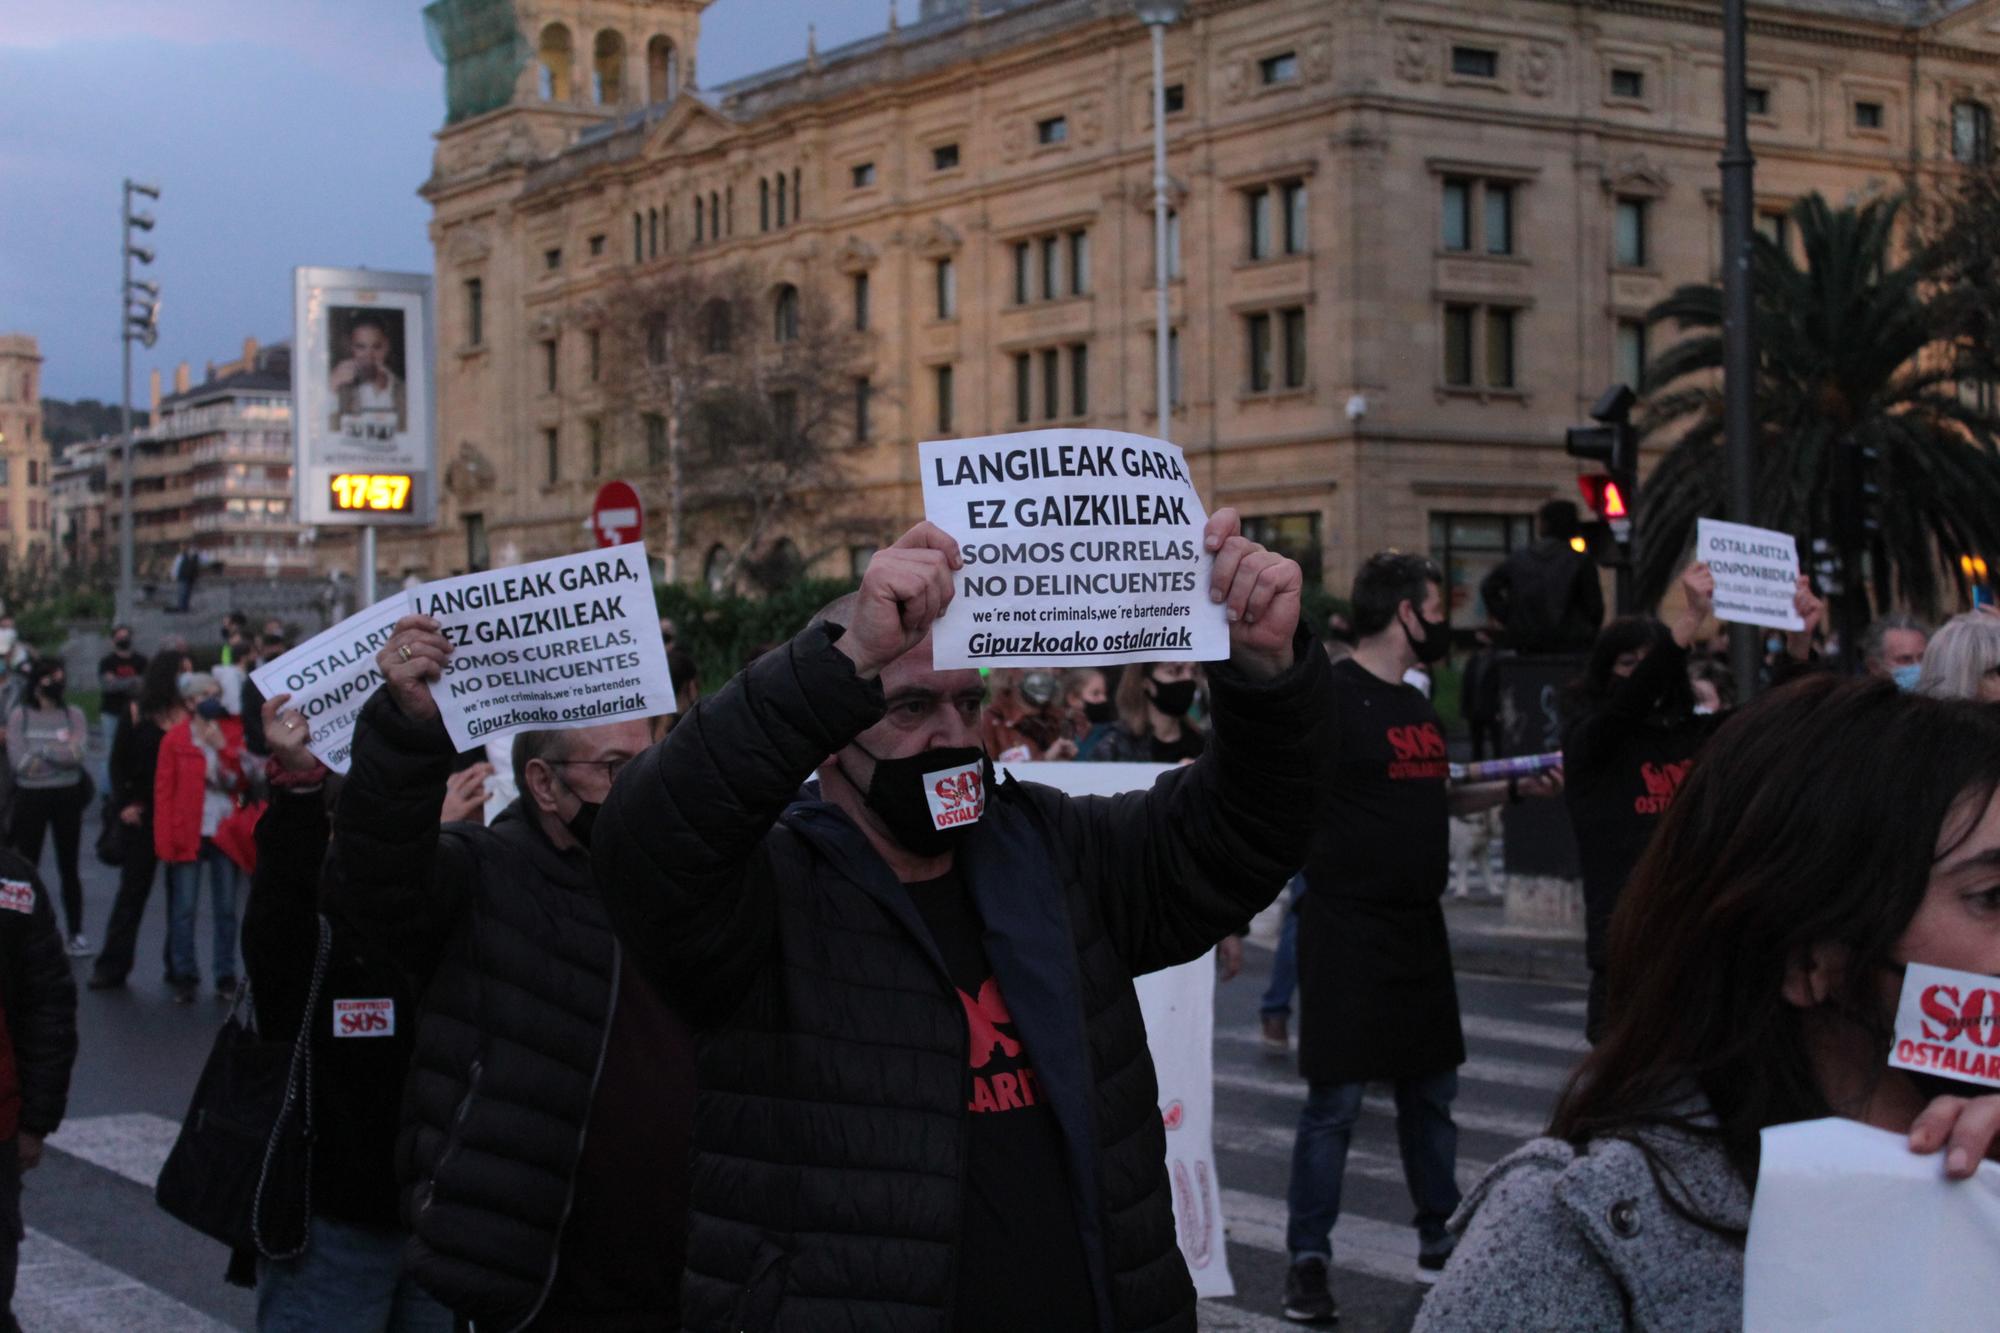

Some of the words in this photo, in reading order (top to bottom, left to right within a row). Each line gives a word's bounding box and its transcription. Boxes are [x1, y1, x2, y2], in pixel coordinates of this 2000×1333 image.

[935, 445, 1121, 487] LANGILEAK
[1121, 447, 1191, 489] GARA,
[967, 499, 1008, 529] EZ
[1014, 495, 1191, 527] GAIZKILEAK
[963, 542, 1065, 565] SOMOS
[1070, 540, 1200, 564] CURRELAS,
[415, 571, 556, 617] LANGILEAK
[558, 557, 640, 592] GARA,
[963, 575, 1007, 598] NO
[1013, 571, 1196, 597] DELINCUENTES
[475, 595, 627, 644] GAIZKILEAK
[1013, 608, 1037, 622] not
[1133, 602, 1191, 619] bartenders
[286, 622, 397, 692] OSTALARIT
[522, 629, 638, 662] CURRELAS,
[967, 630, 1098, 657] Gipuzkoako
[1102, 626, 1193, 651] ostalariak
[450, 677, 483, 699] NO
[486, 651, 641, 689] DELINCUENTES
[491, 693, 510, 705] not
[584, 675, 641, 696] bartenders
[467, 708, 558, 740] Gipuzkoako
[562, 692, 648, 720] ostalariak
[1641, 759, 1694, 797] SO
[1634, 796, 1673, 815] OST
[340, 1011, 388, 1034] SOS
[1920, 984, 2000, 1048] SO
[1896, 1039, 2000, 1079] OSTALAR
